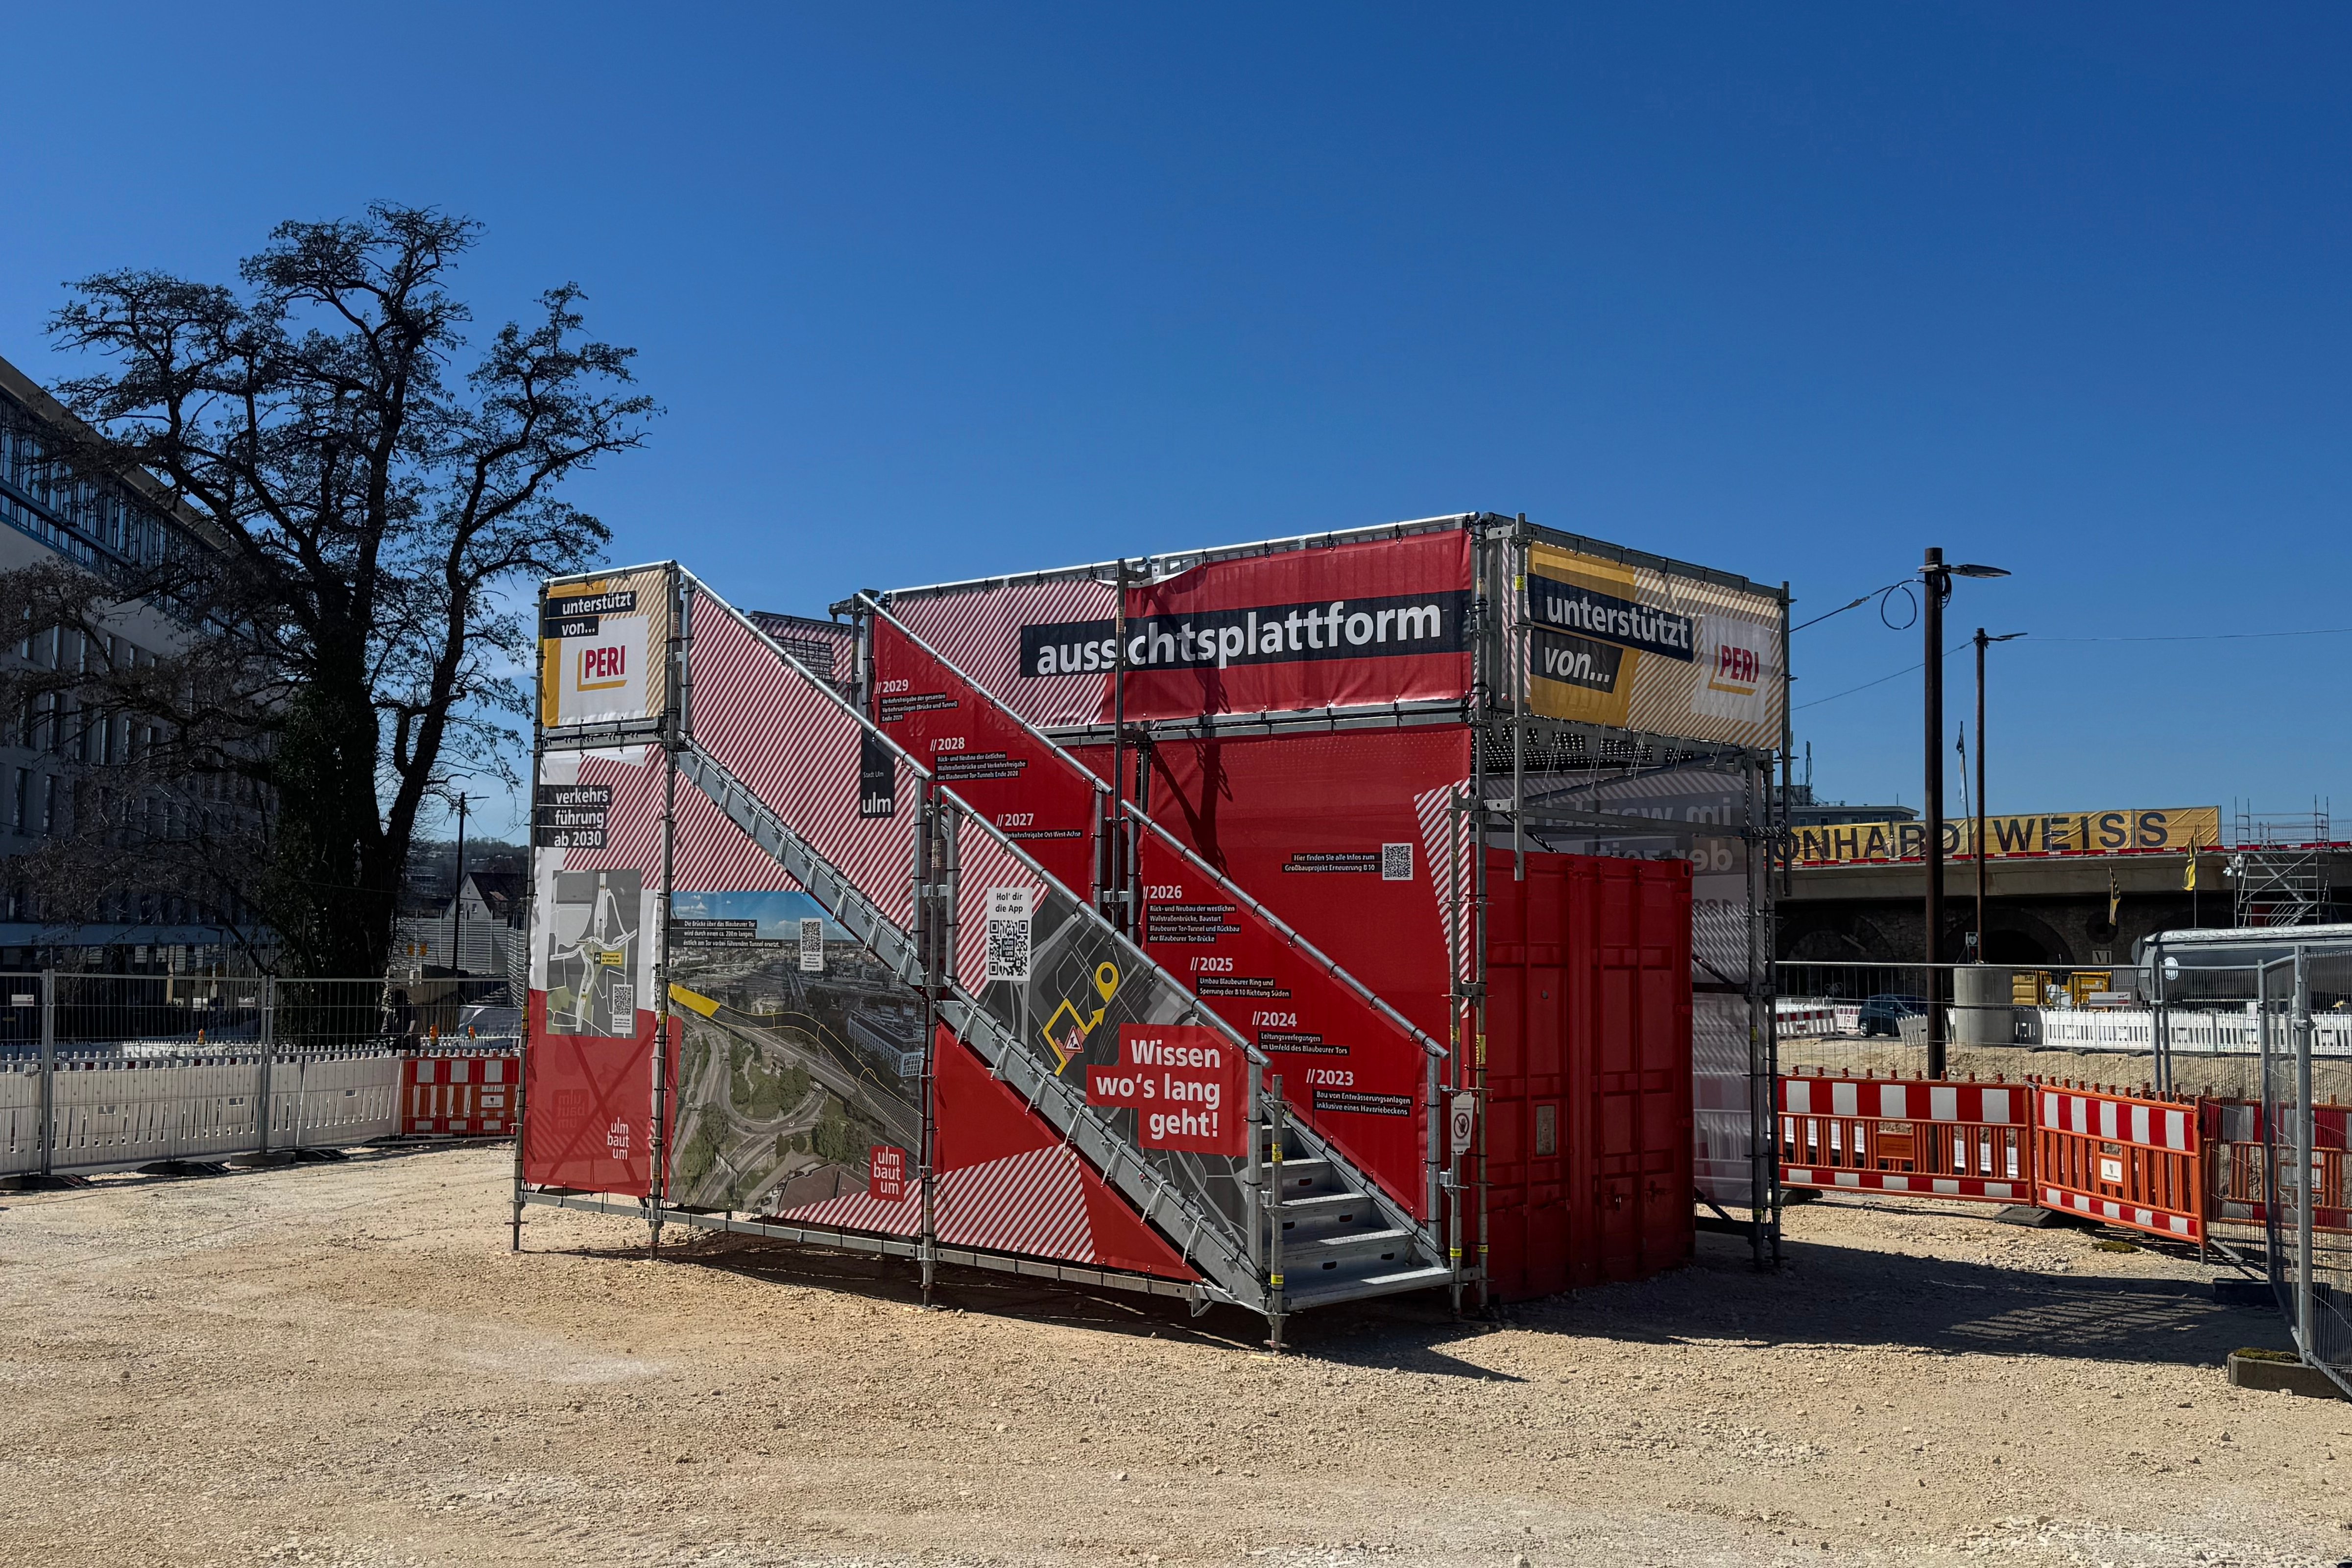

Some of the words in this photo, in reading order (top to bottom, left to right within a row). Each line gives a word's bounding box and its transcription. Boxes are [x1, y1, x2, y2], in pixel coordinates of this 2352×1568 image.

[562, 591, 632, 615] unterstützt
[562, 621, 595, 637] von...
[1547, 596, 1688, 649] unterstützt
[1037, 601, 1441, 675] ausschtsplattform
[584, 645, 625, 679] PERI
[1545, 646, 1610, 683] von...
[1719, 645, 1759, 683] PERI
[556, 788, 608, 804] verkehrs
[863, 792, 891, 814] ulm
[555, 808, 605, 828] führung
[554, 832, 569, 848] ab
[573, 831, 601, 846] 2030
[1992, 812, 2169, 852] WEISS
[1012, 892, 1023, 900] dir
[1008, 905, 1023, 914] App
[2095, 952, 2109, 963] VI
[1249, 979, 1261, 987] Ring
[1200, 988, 1224, 996] Sperrung
[1247, 989, 1270, 998] Richtung
[1130, 1039, 1220, 1069] Wissen
[1096, 1073, 1155, 1098] wo's
[1164, 1073, 1220, 1110] lang
[1317, 1102, 1343, 1110] inklusive
[611, 1117, 629, 1134] ulm
[1150, 1110, 1218, 1140] geht!
[607, 1133, 629, 1148] baut
[613, 1149, 628, 1160] um
[878, 1146, 900, 1166] ulm
[874, 1163, 901, 1181] baut
[881, 1181, 899, 1195] um
